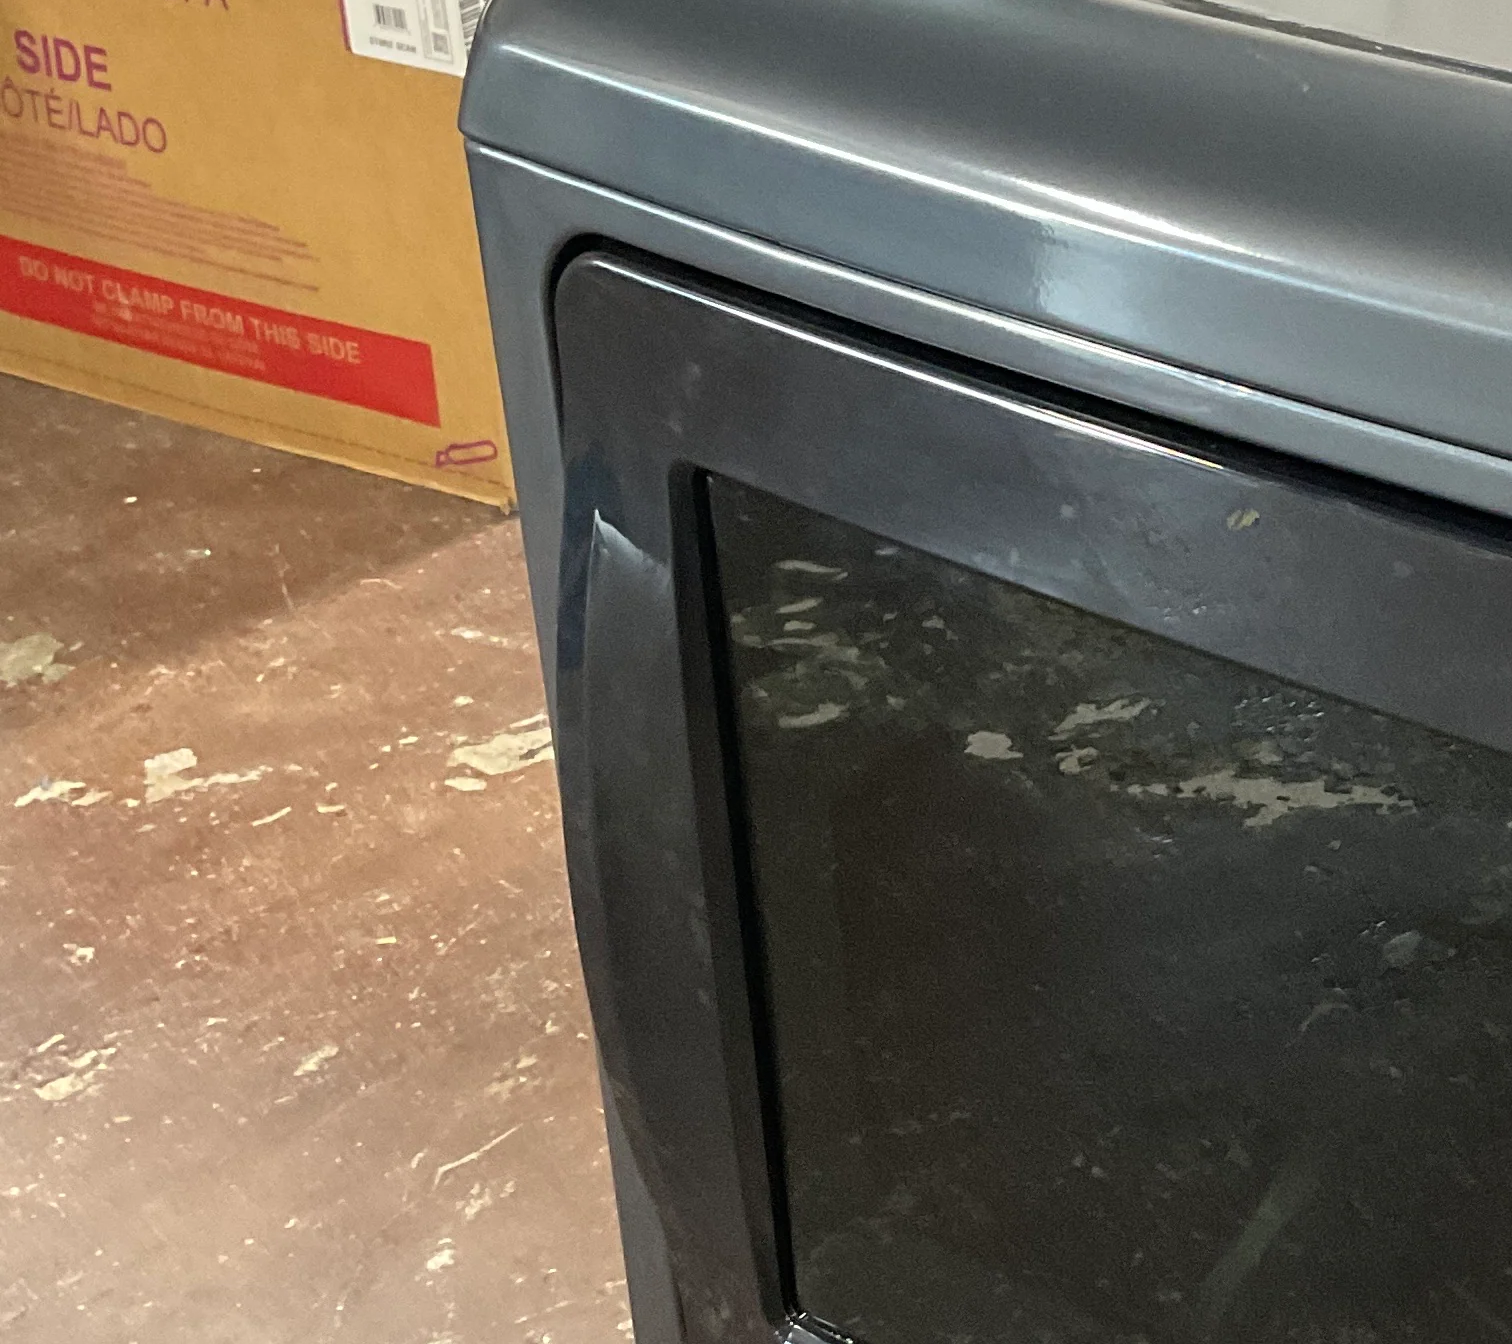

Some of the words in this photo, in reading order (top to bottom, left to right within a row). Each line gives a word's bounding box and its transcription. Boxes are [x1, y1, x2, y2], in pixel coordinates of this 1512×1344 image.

[14, 30, 112, 92] SIDE
[19, 256, 49, 282] DO
[54, 268, 95, 296] NOT
[101, 279, 175, 316] CLAMP
[179, 299, 246, 337] FROM
[249, 317, 302, 350] THIS
[306, 332, 361, 364] SIDE
